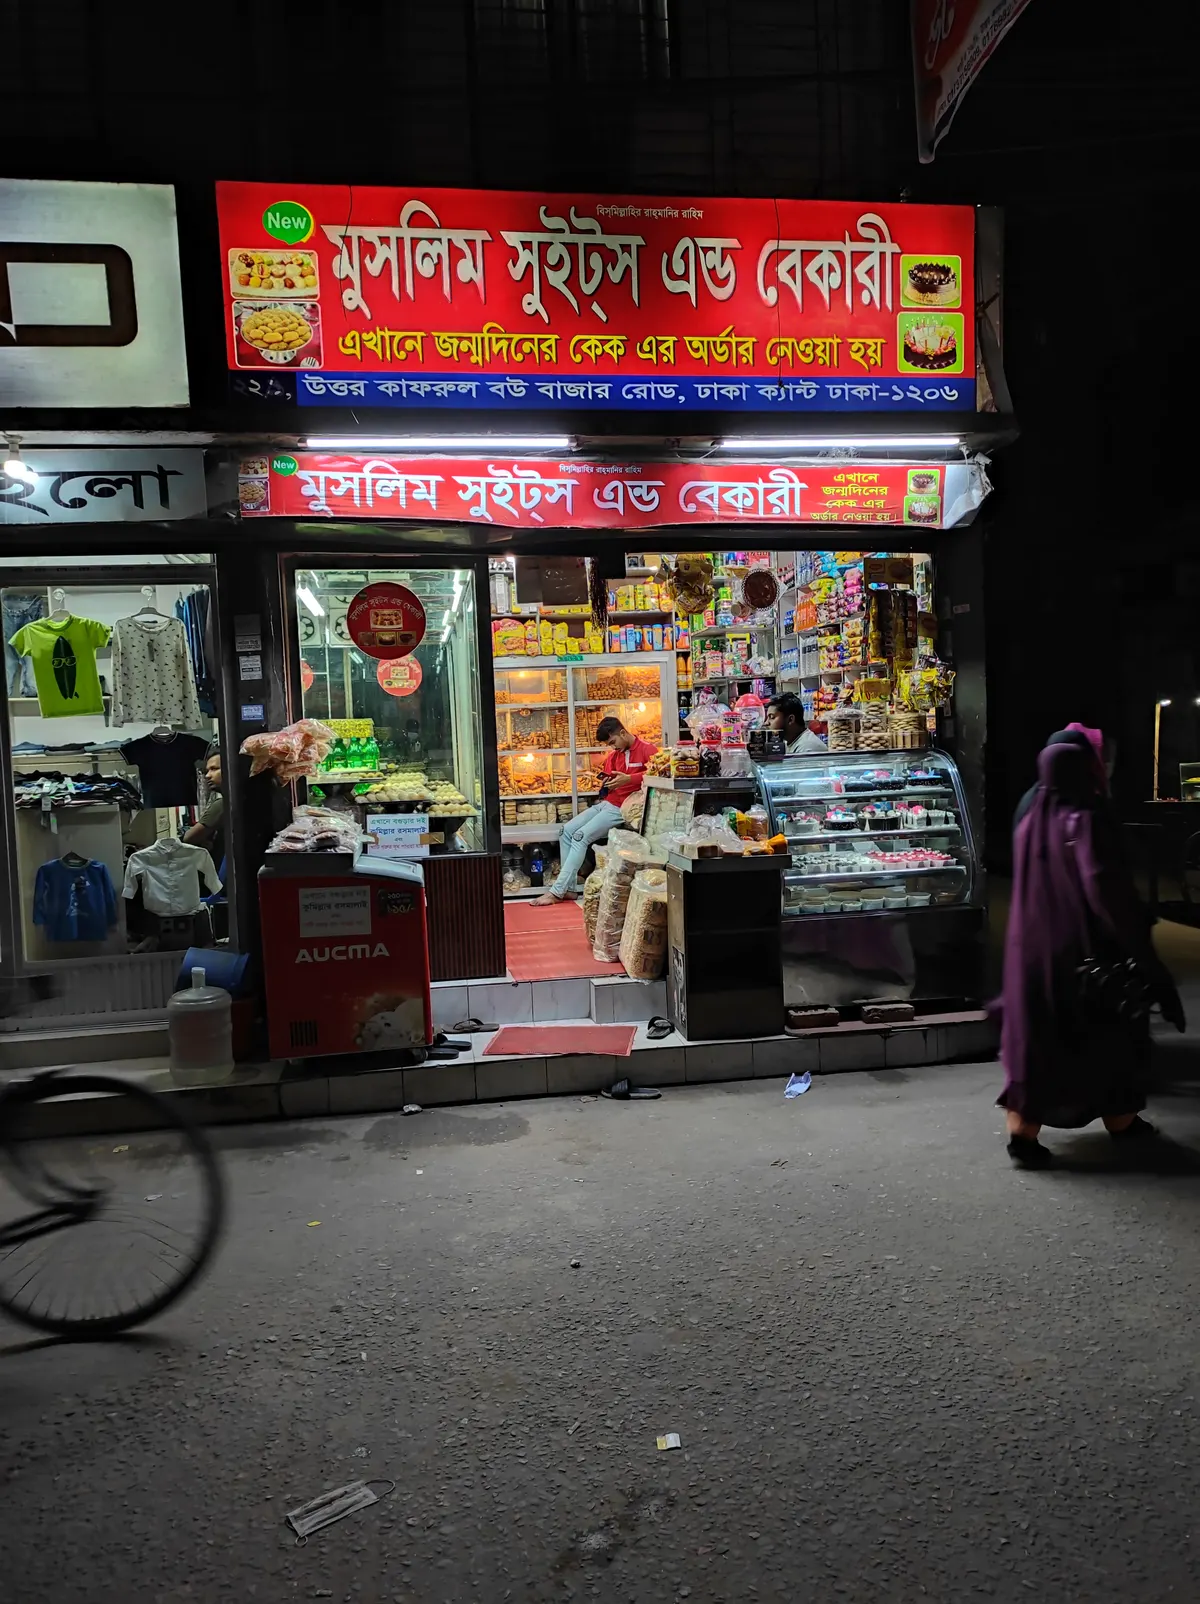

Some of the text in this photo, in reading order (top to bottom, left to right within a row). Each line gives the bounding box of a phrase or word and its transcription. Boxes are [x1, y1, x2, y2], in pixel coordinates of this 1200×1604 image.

[266, 212, 307, 230] New
[320, 200, 492, 320] মুসলিম
[661, 236, 742, 309] এন্ড
[757, 212, 902, 314] বেকারী
[338, 321, 887, 371] এখানে জন্মদিনের কেক এর অর্ডার নেওয়া হয়
[302, 373, 369, 398] উত্তর
[377, 380, 480, 399] কাফরুল
[485, 376, 529, 400] বউ
[534, 382, 613, 400] বাজার
[622, 383, 686, 403] রোড,
[693, 383, 750, 401] ঢাকা
[757, 379, 820, 402] ক্যান্ট
[825, 383, 959, 403] ঢাকা-১২০৬
[272, 459, 295, 470] New
[833, 472, 880, 483] এখানে
[296, 460, 446, 518] মুসলিম
[593, 480, 666, 517] এন্ড
[679, 468, 808, 517] বেকারী
[821, 483, 890, 496] জন্মদিনের
[826, 499, 886, 509] কেক এর
[810, 510, 839, 521] অর্ডার
[843, 512, 874, 521] নেওয়া
[294, 942, 390, 964] AUCMA
